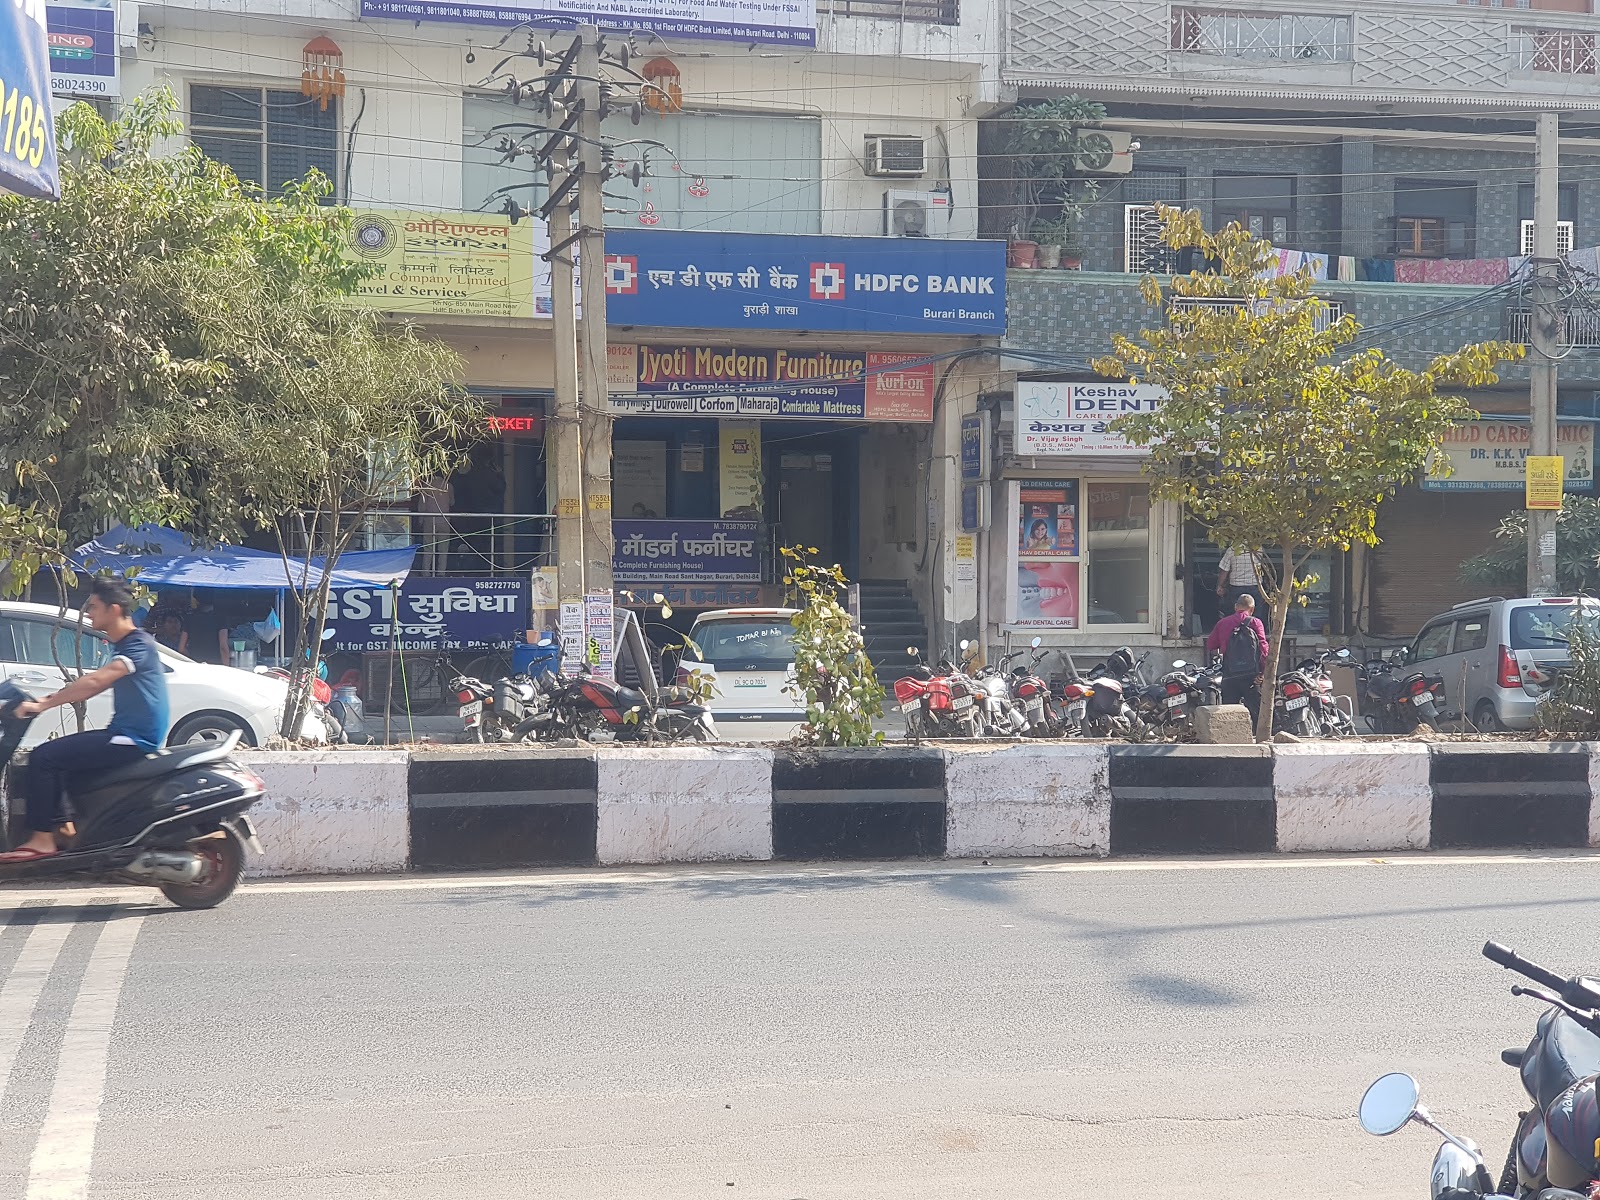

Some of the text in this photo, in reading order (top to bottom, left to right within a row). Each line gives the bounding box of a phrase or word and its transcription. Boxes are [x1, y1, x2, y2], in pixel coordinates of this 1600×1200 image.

[558, 1, 595, 10] Notification
[597, 3, 609, 11] And
[610, 4, 628, 12] NABL
[720, 0, 738, 9] Water
[739, 2, 762, 12] Testing
[763, 3, 781, 11] Under
[663, 24, 676, 32] Floor
[684, 25, 699, 33] HDFC
[700, 26, 712, 34] Bank
[49, 47, 84, 57] TET
[448, 262, 494, 276] लिमिटेड
[390, 271, 451, 287] Company
[457, 273, 508, 287] Limited
[647, 264, 799, 290] एच डी एफ सी बैंक
[854, 273, 995, 296] HDFC BANK
[392, 285, 405, 295] &
[406, 286, 467, 298] Services
[774, 305, 799, 317] शाखा
[924, 308, 996, 320] Burari Branch
[639, 345, 687, 383] Jyoti
[694, 347, 768, 379] Modern
[775, 350, 863, 382] Furniture
[1074, 386, 1138, 398] Keshav
[656, 398, 693, 412] Durowell
[699, 399, 735, 411] Corfom
[740, 397, 779, 412] Maharaja
[824, 400, 862, 415] Mattress
[1074, 399, 1157, 411] DENT
[487, 416, 534, 430] ICKET
[1028, 420, 1087, 434] केशव
[1041, 436, 1059, 444] Vijay
[1062, 436, 1083, 444] Singh
[1443, 425, 1481, 443] HILD
[1486, 425, 1530, 443] CARE
[1470, 448, 1490, 459] DR.
[1493, 449, 1515, 460] K.K.
[618, 561, 704, 572] Complete Furnishing House)
[695, 574, 714, 582] Nagar,
[475, 581, 521, 589] 9582727750
[408, 587, 518, 623] सुविधा
[736, 630, 760, 643] TOMAR
[347, 641, 364, 651] for
